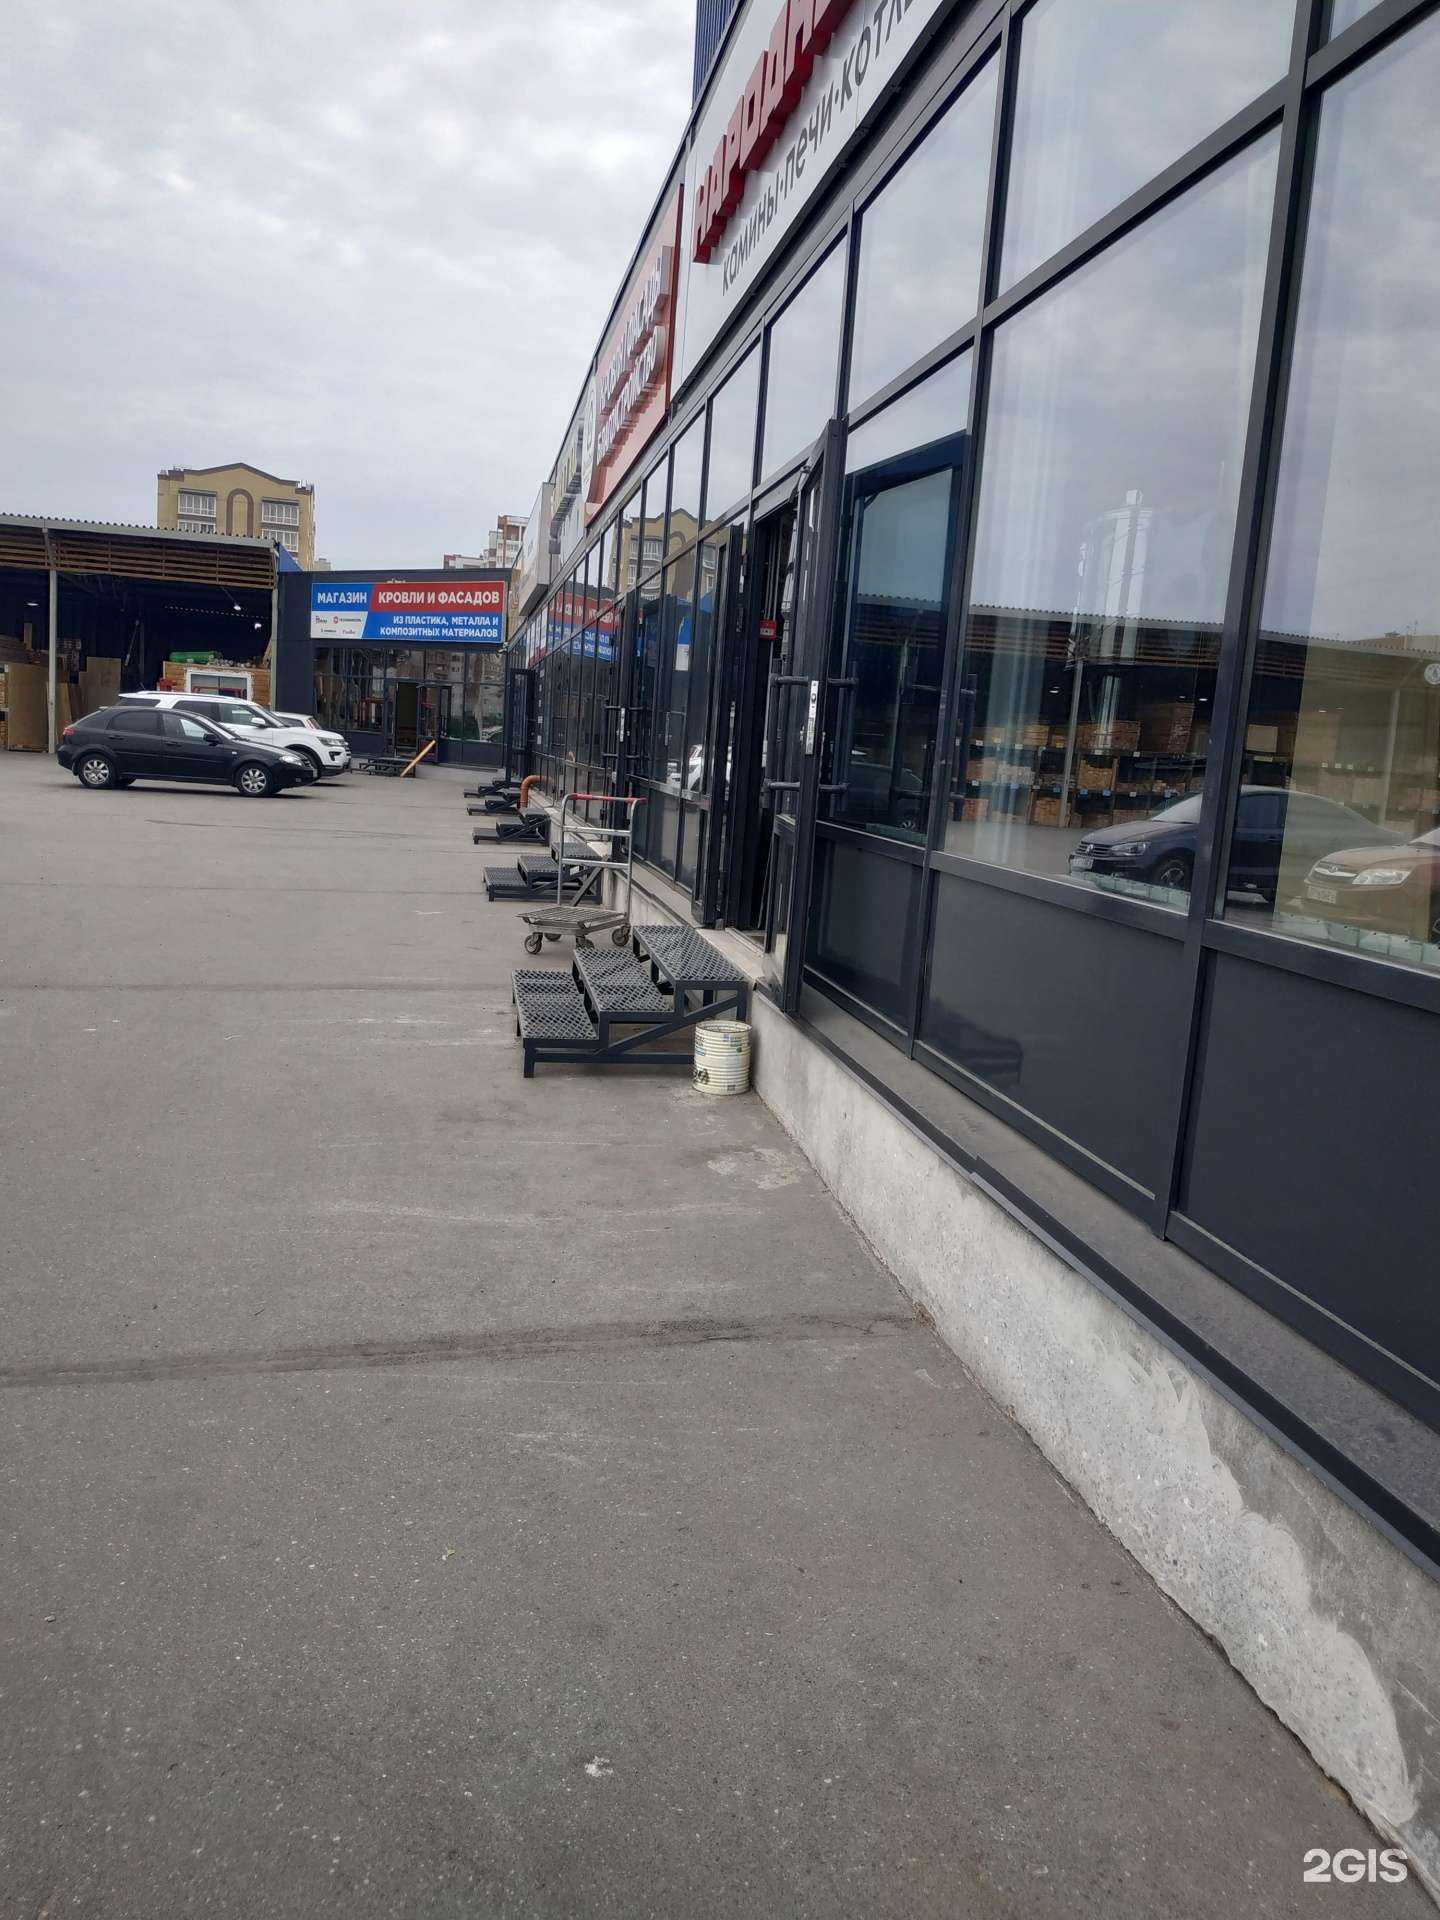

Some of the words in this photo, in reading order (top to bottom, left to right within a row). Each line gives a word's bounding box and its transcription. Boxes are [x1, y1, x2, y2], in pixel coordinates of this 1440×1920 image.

[693, 0, 845, 263] НАРОДН
[317, 591, 367, 604] МАГАЗИН
[378, 591, 424, 604] КРОВЛИ
[427, 591, 435, 604] И
[438, 591, 500, 606] ФАСАДОВ
[393, 616, 403, 624] ИЗ
[405, 616, 448, 626] ПЛАСТИКА,
[451, 616, 490, 625] МЕТАЛЛА
[493, 616, 498, 625] И
[380, 627, 440, 636] КОМПОЗИТНЫХ
[442, 628, 498, 638] МАТЕРИАЛОВ
